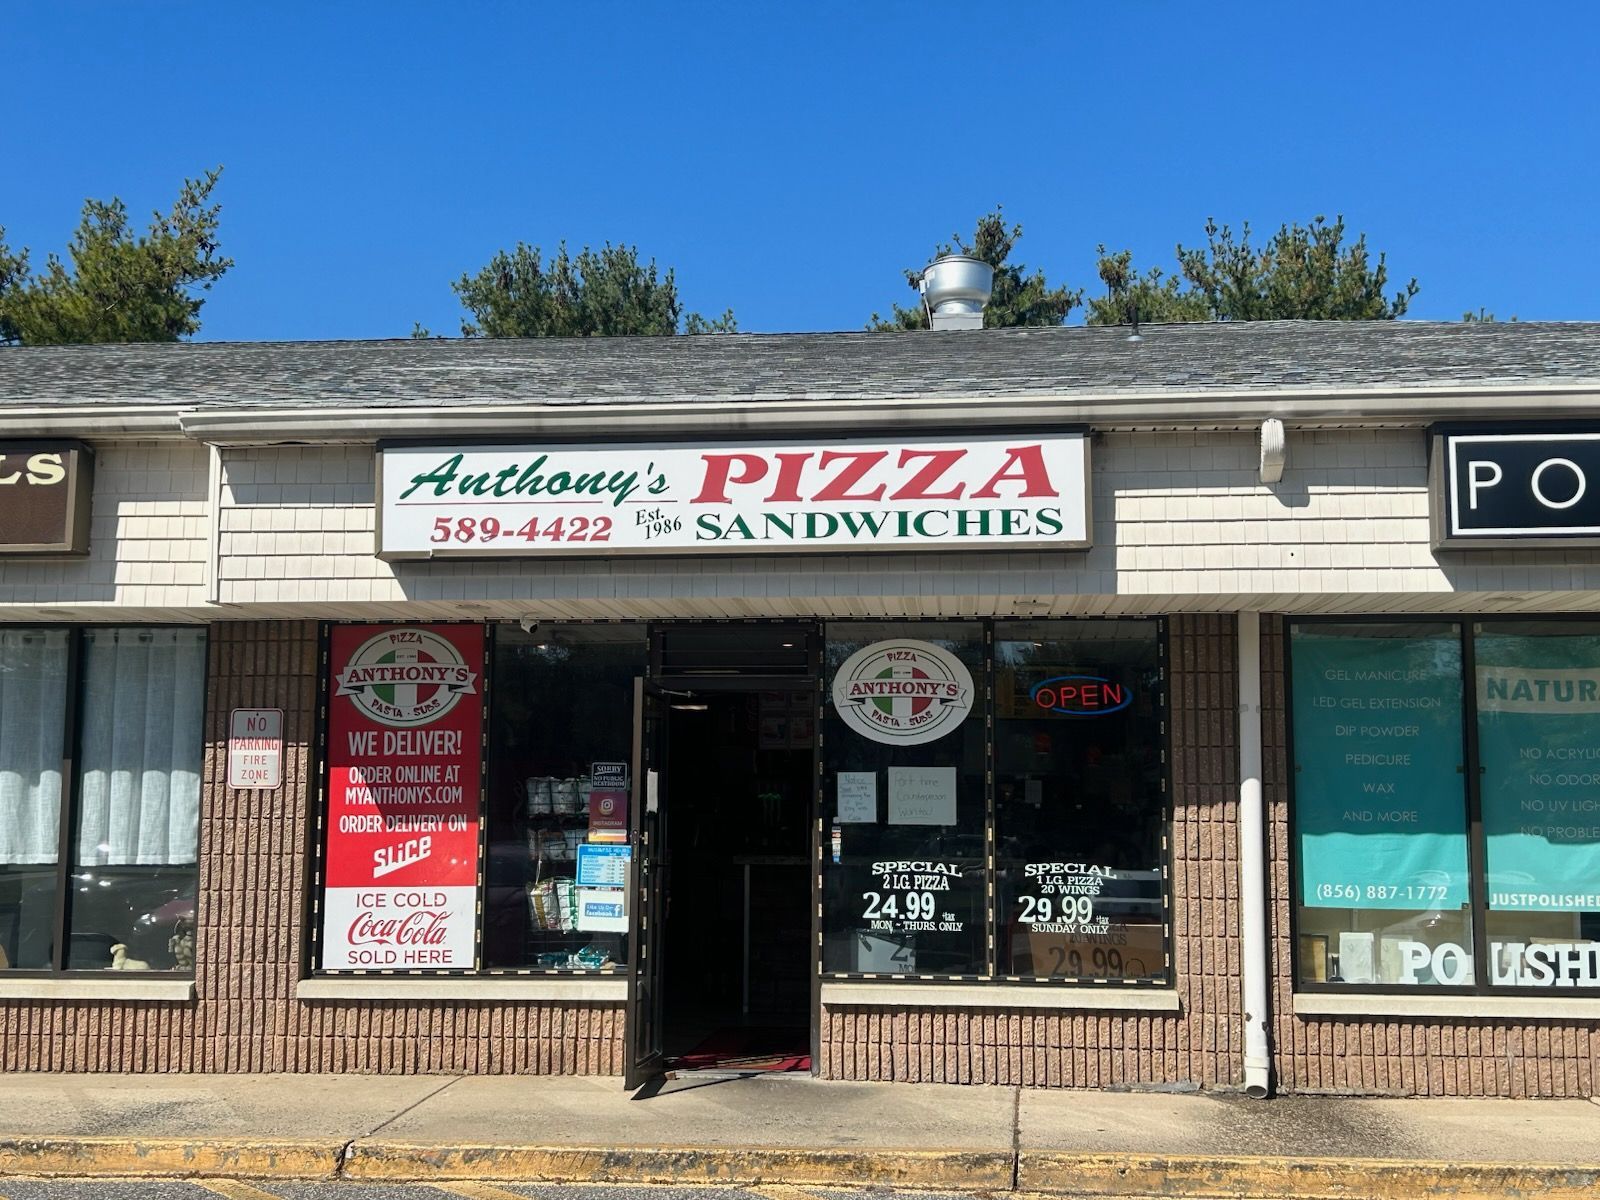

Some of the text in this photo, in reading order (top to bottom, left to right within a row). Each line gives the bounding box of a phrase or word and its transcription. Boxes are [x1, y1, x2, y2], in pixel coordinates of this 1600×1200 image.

[400, 453, 670, 507] Anthony's
[690, 444, 1060, 505] PIZZA
[1469, 457, 1586, 509] PO
[636, 507, 665, 528] Est.
[696, 508, 1063, 541] SANDWICHES
[430, 516, 613, 543] 589-4422
[646, 515, 682, 541] 1986
[347, 666, 469, 684] ANTHONY'S
[1324, 669, 1427, 681] GEL MANICURE
[849, 681, 959, 696] ANTHONY'S
[1036, 684, 1121, 708] OPEN
[1487, 677, 1600, 703] NATUR
[371, 698, 441, 718] PASTA SUBS
[1313, 696, 1441, 709] LED GEL EXTENSION
[247, 717, 267, 731] NO
[871, 709, 933, 727] PASTA SUBS
[1335, 725, 1420, 737] DIP POWDER
[233, 736, 278, 750] PARKING
[348, 730, 462, 756] WE DELIVER!
[243, 755, 267, 765] FIRE
[1345, 753, 1411, 765] PEDICURE
[1519, 748, 1542, 760] NO
[241, 769, 268, 780] ZONE
[349, 765, 461, 784] ORDER ONLINE AT
[596, 765, 622, 773] SORRY
[1363, 783, 1395, 793] WAX
[1529, 774, 1551, 786] NO
[345, 786, 463, 805] MYANTHONYS.COM
[1520, 800, 1544, 812] NO
[1549, 799, 1568, 812] UV
[339, 813, 467, 833] ORDER DELIVERY ON
[1342, 811, 1418, 822] AND MORE
[1520, 826, 1544, 837] NO
[872, 861, 962, 877] SPECIAL
[1025, 863, 1117, 879] SPECIAL
[883, 874, 890, 889] 2
[914, 875, 950, 891] PIZZA
[1036, 876, 1043, 884] 1
[1067, 876, 1104, 886] PIZZA
[1041, 885, 1101, 895] 20 WINGS
[1317, 884, 1448, 901] (856) 887-1772
[356, 892, 447, 908] ICE COLD
[862, 892, 935, 920] 24.99
[1490, 893, 1600, 907] JUSTPOLISHE
[1018, 895, 1093, 924] 29.99
[938, 922, 963, 932] ONLY
[1032, 923, 1077, 934] SUNDAY
[1080, 924, 1109, 934] ONLY
[348, 950, 453, 964] SOLD HERE
